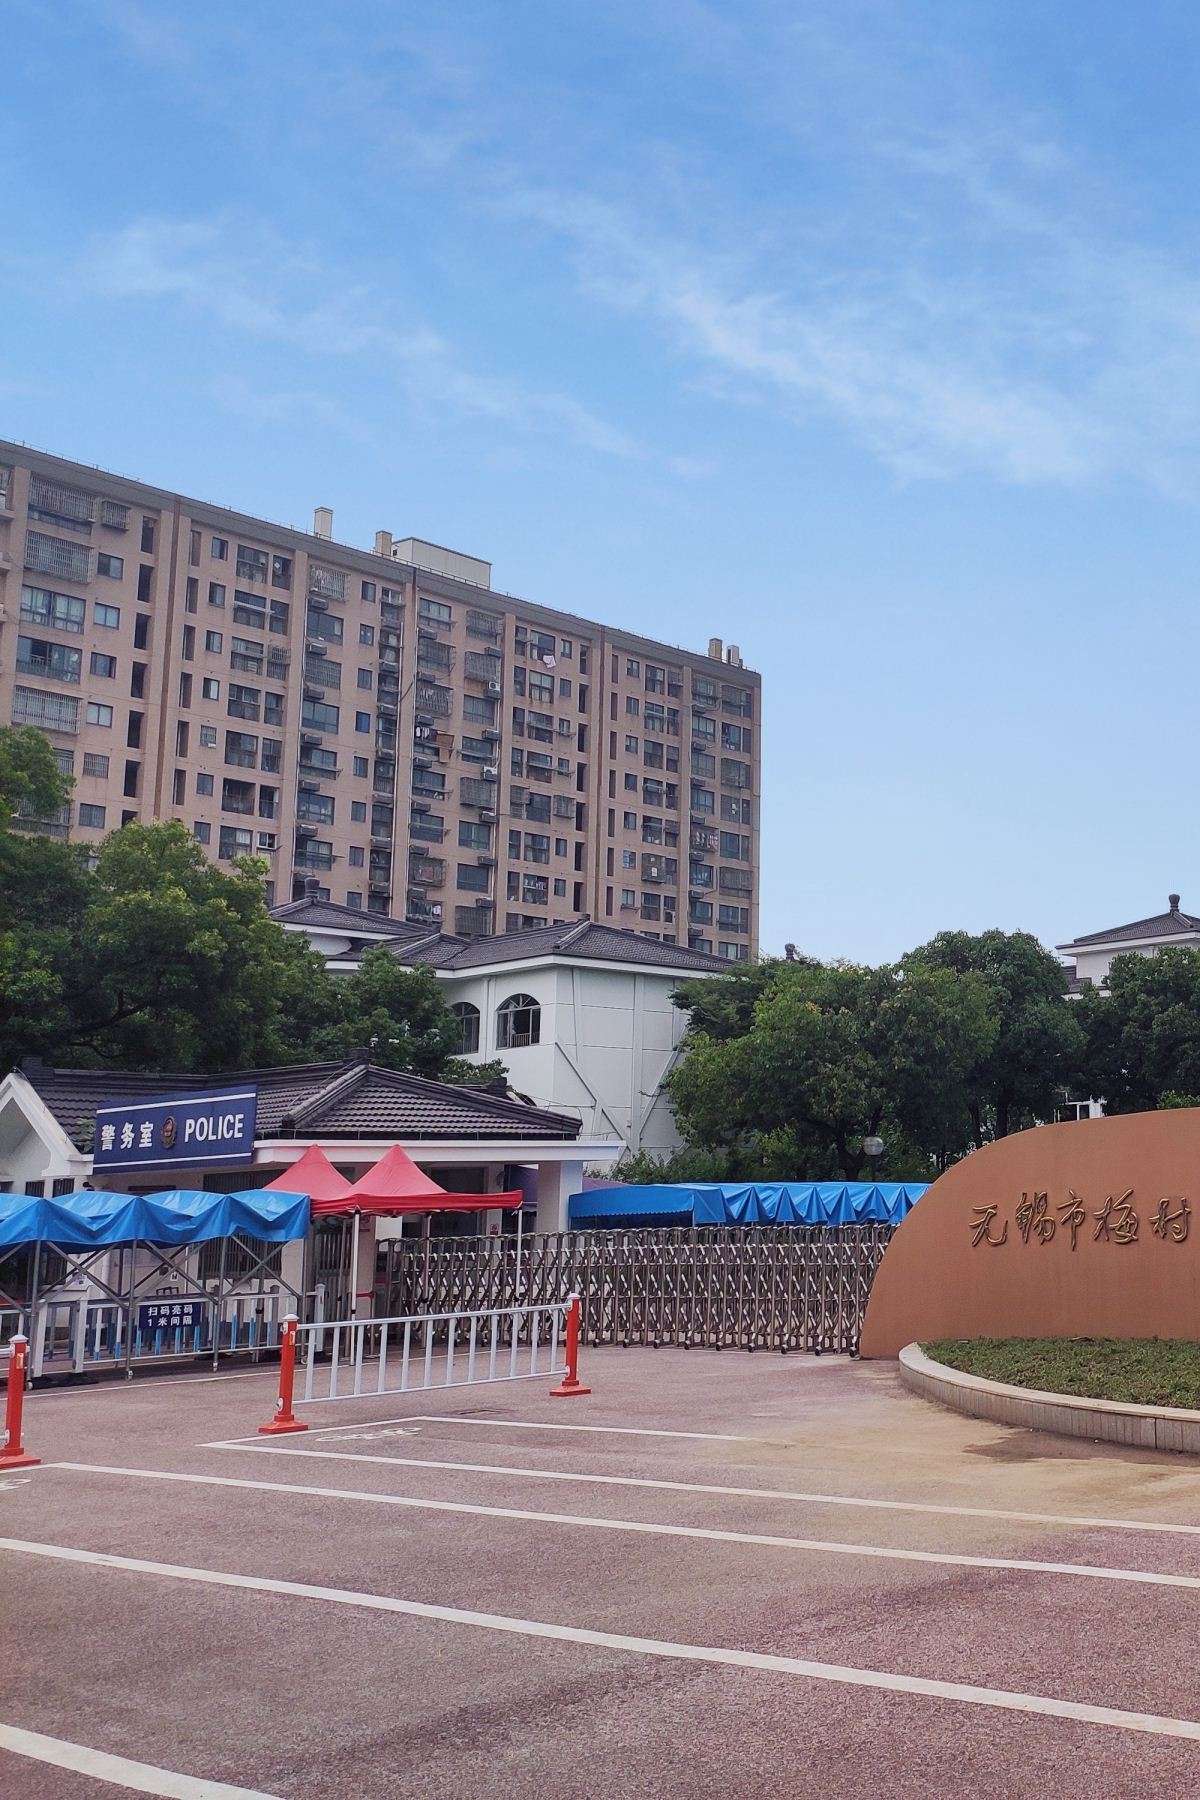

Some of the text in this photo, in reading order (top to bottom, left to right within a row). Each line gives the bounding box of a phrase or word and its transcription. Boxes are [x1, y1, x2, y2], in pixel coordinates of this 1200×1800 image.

[101, 1121, 154, 1151] 警务室
[184, 1114, 244, 1142] POLICE
[147, 1304, 193, 1316] 扫码亮码
